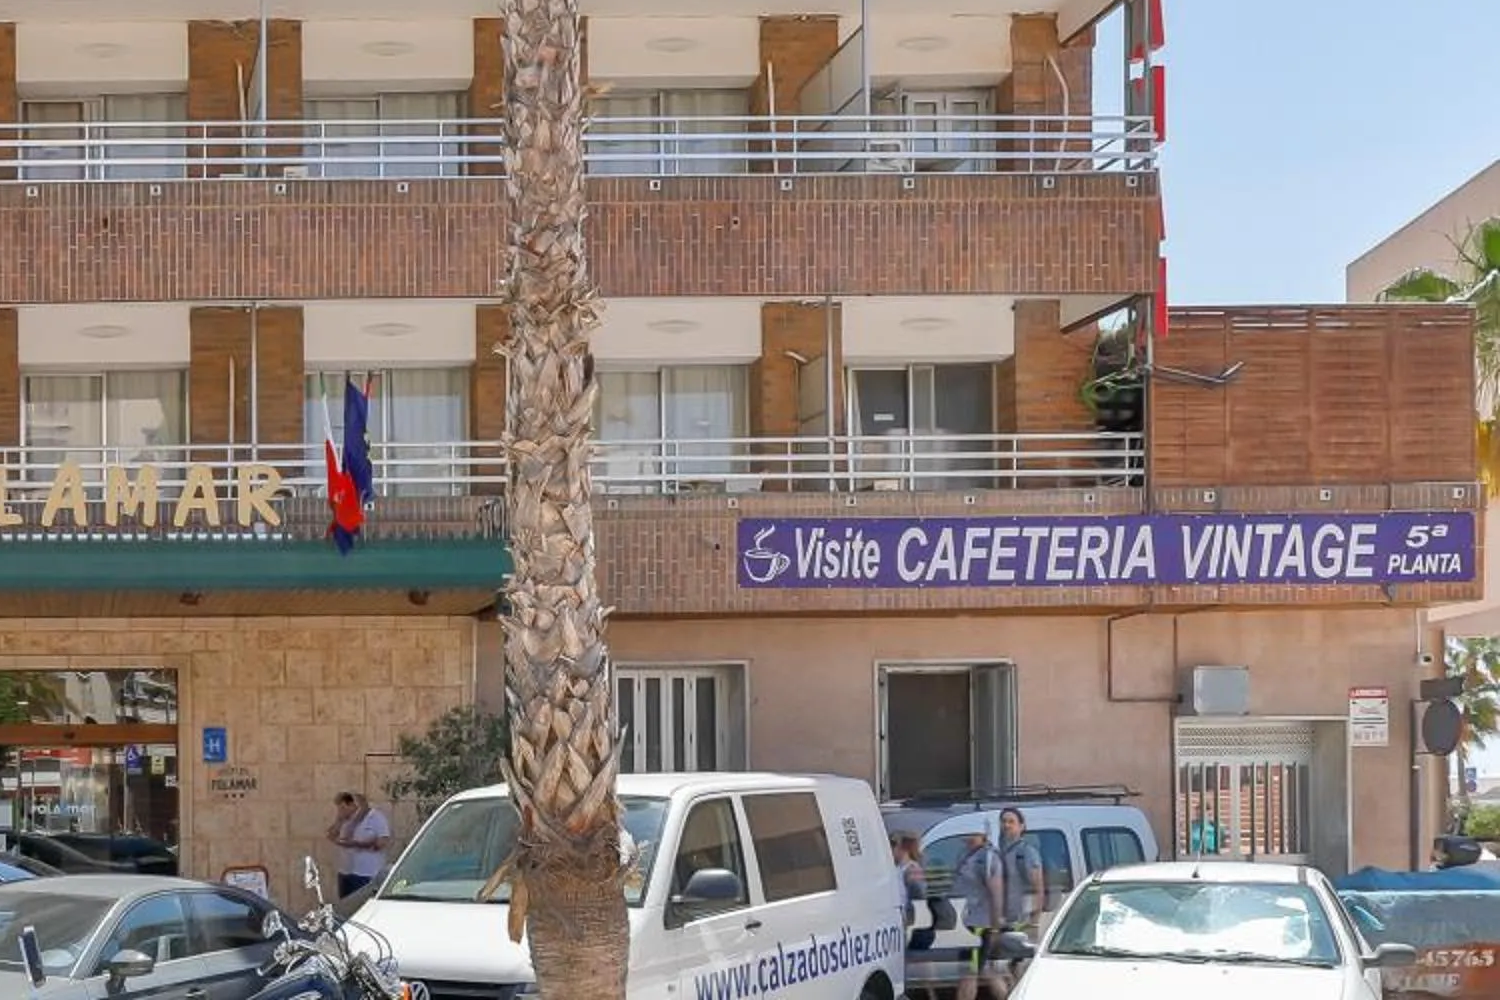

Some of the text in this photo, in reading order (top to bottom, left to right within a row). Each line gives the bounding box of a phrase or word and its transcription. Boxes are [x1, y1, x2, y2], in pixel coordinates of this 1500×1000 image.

[795, 523, 1378, 582] Visite CAFETERIA VINTAGE
[1386, 552, 1463, 575] PLANTA
[694, 924, 901, 1000] www.calzadosdiez.com
